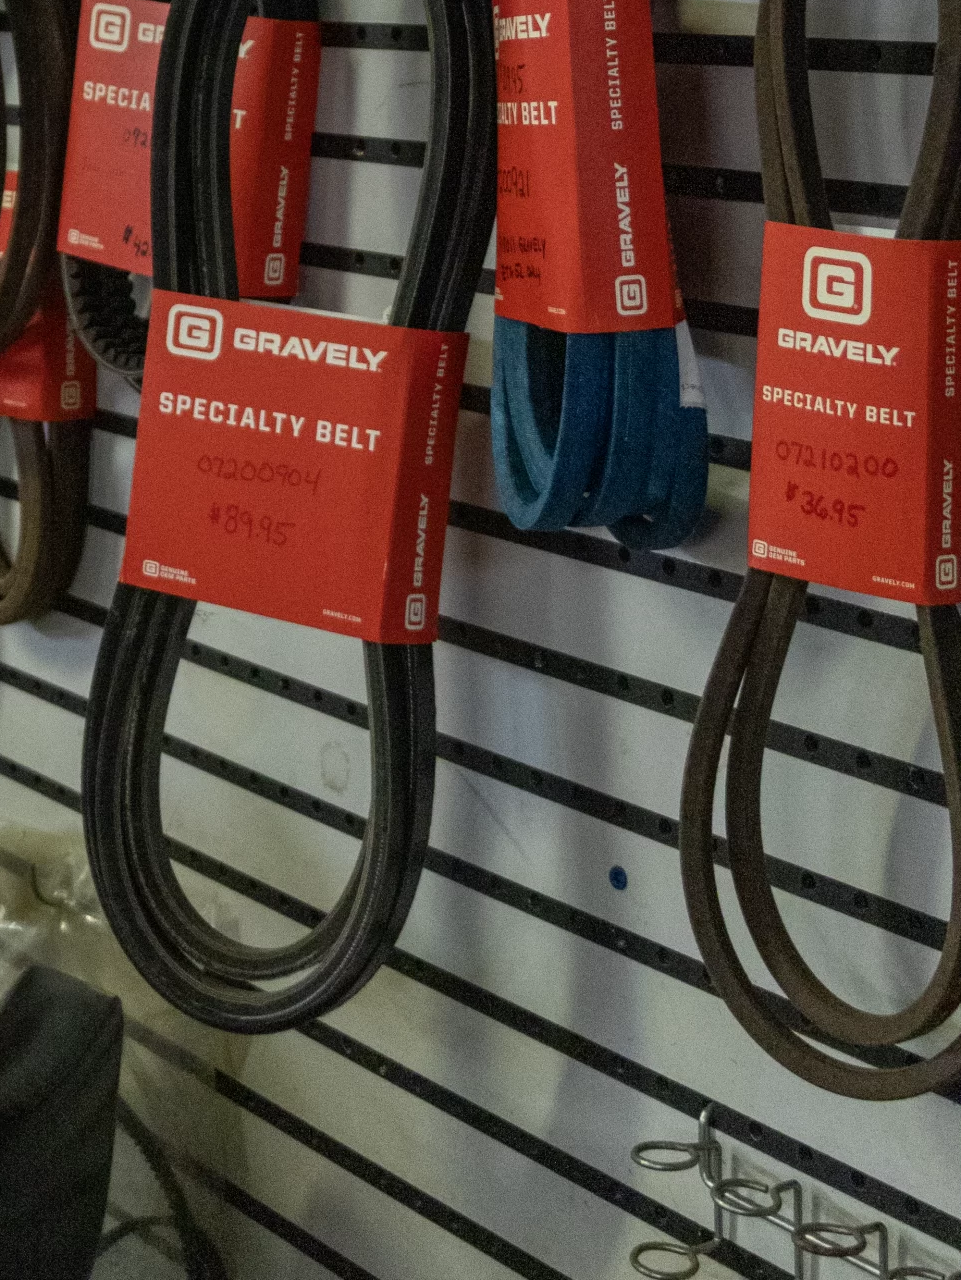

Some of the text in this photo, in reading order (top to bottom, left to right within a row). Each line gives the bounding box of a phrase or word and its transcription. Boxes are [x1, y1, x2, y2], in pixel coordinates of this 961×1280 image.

[82, 81, 151, 112] SPECIA
[604, 36, 623, 131] SPECIALTY
[521, 100, 558, 126] BELT
[272, 166, 289, 248] GRAVELY
[284, 64, 300, 141] SPECIALTY
[614, 162, 635, 268] GRAVELY
[947, 259, 959, 300] BELT
[233, 327, 388, 372] GRAVELY
[777, 328, 900, 367] GRAVELY
[944, 305, 958, 398] SPECIALTY
[159, 391, 381, 452] SPECIALTY BELT
[762, 385, 916, 428] SPECIALTY BELT
[413, 493, 430, 588] GRAVELY
[424, 382, 443, 465] SPECIALTY
[436, 344, 449, 378] BELT
[775, 440, 899, 480] 07210200
[942, 459, 954, 548] GRAVELY
[784, 554, 806, 566] PARTS
[872, 575, 915, 589] GRAVELY.COM
